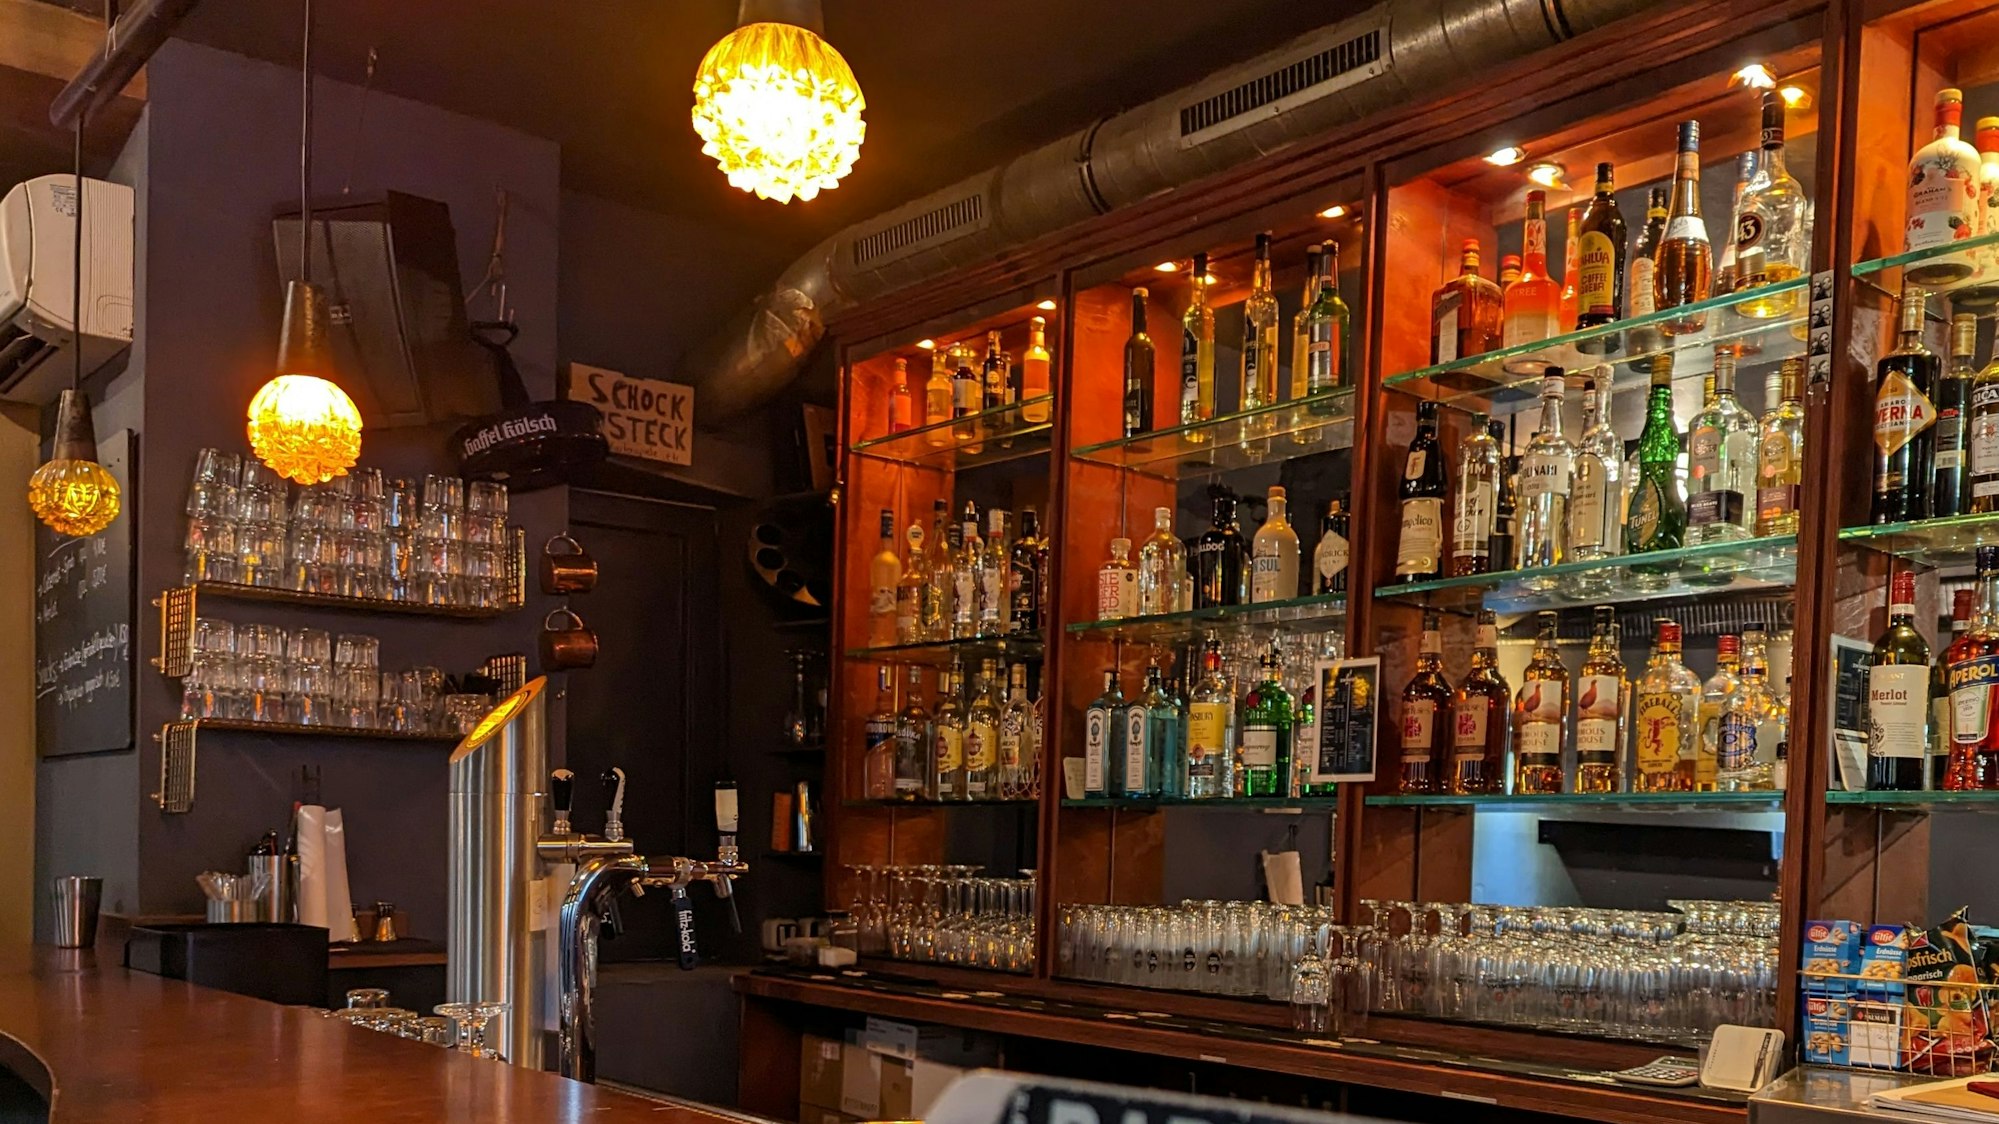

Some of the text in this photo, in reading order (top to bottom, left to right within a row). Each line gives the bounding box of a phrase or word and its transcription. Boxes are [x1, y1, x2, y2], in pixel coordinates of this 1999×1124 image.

[1739, 220, 1756, 240] 43
[588, 373, 686, 422] SCHOCK
[463, 413, 557, 457] Gaffel Kölsch
[1260, 559, 1281, 572] SUL
[1949, 663, 1997, 688] APEROL
[1871, 688, 1907, 702] Merlot
[1640, 697, 1677, 716] FIREBALL
[679, 909, 697, 954] fritz-kola
[1810, 927, 1828, 941] ültje
[1875, 930, 1893, 945] ültje
[1876, 947, 1902, 957] Erdnüsse
